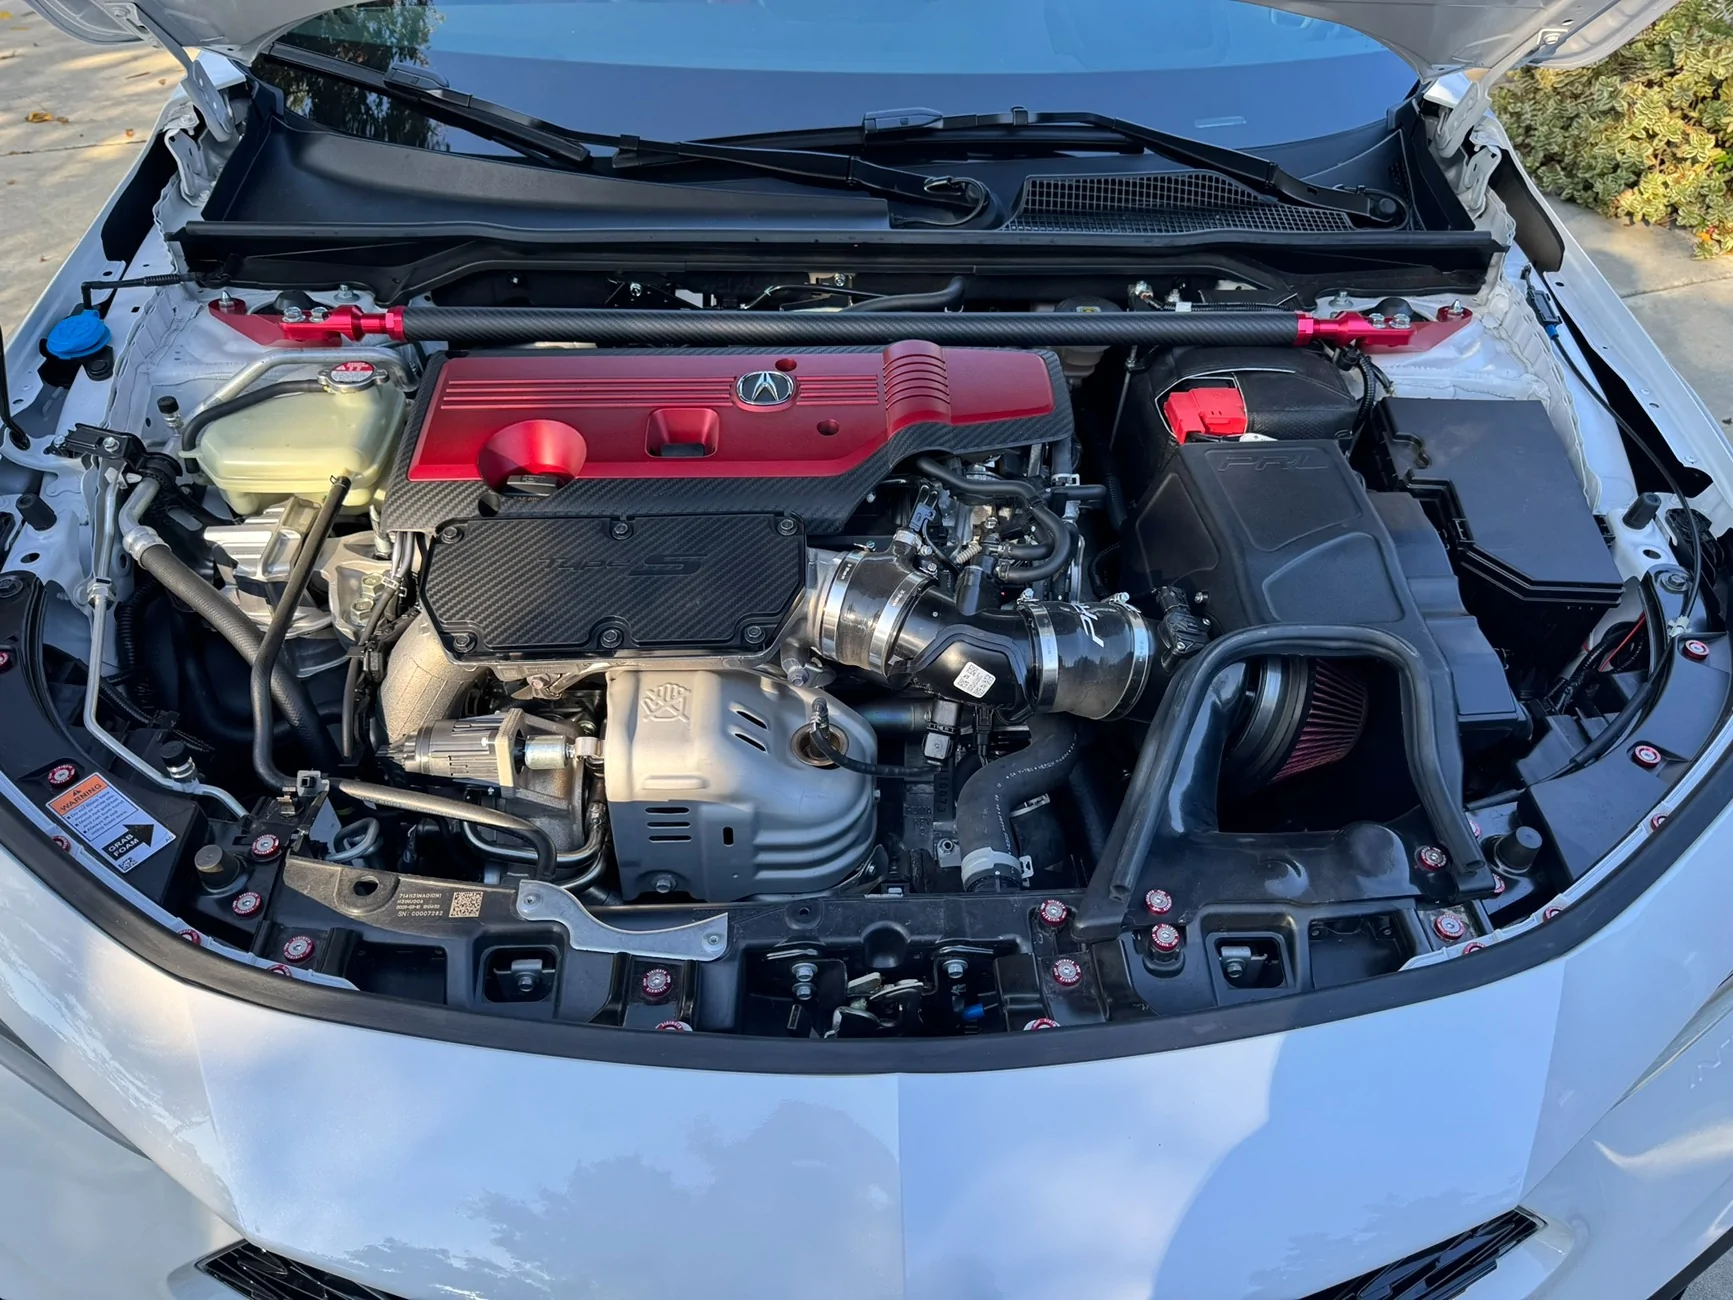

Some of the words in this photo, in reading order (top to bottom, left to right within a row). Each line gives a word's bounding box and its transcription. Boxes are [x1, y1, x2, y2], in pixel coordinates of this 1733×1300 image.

[60, 783, 102, 812] WARNING
[108, 833, 134, 852] GRAB
[113, 838, 140, 857] FOAM
